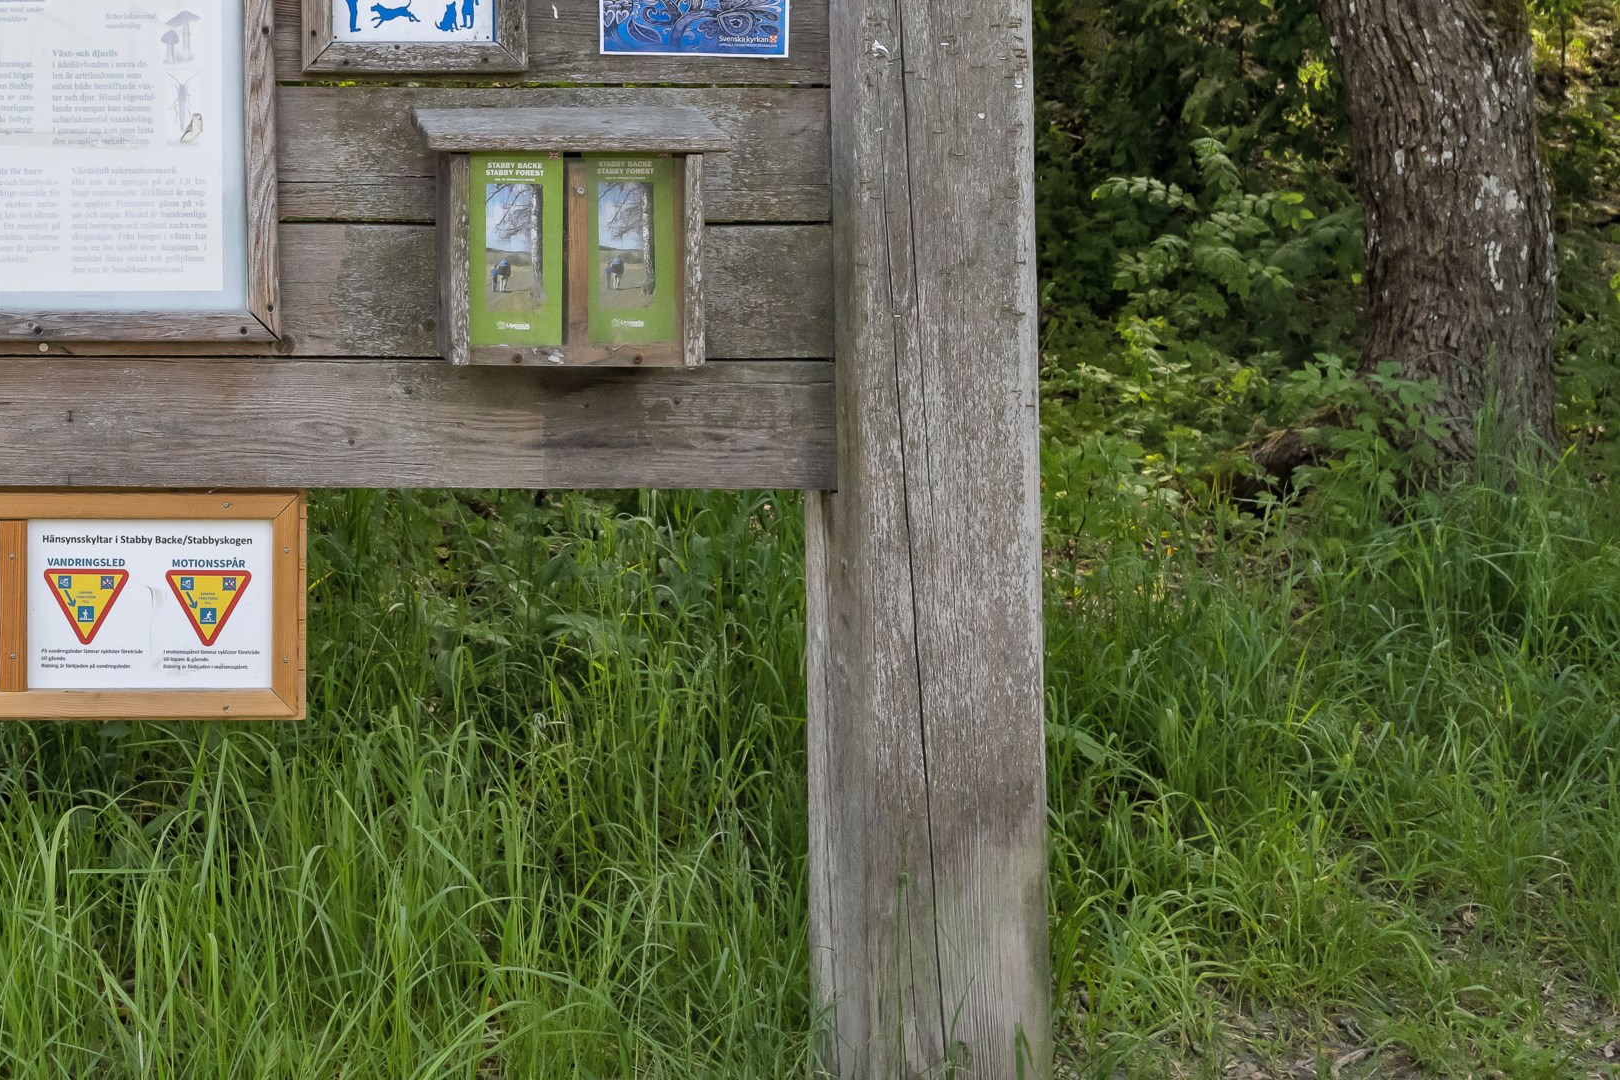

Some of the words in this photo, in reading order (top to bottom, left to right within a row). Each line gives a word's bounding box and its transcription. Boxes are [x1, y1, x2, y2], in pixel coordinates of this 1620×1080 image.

[718, 35, 745, 43] Svenska
[745, 36, 769, 44] kyrkan
[42, 535, 112, 546] Hänsynsskyltar
[120, 535, 152, 547] Stabby
[154, 535, 253, 547] Backe/Stabbyskogen
[47, 558, 126, 567] VANDRINGSLED
[172, 556, 246, 568] MOTIONSSPÅR
[190, 656, 210, 664] gående.
[163, 663, 181, 671] Ridning
